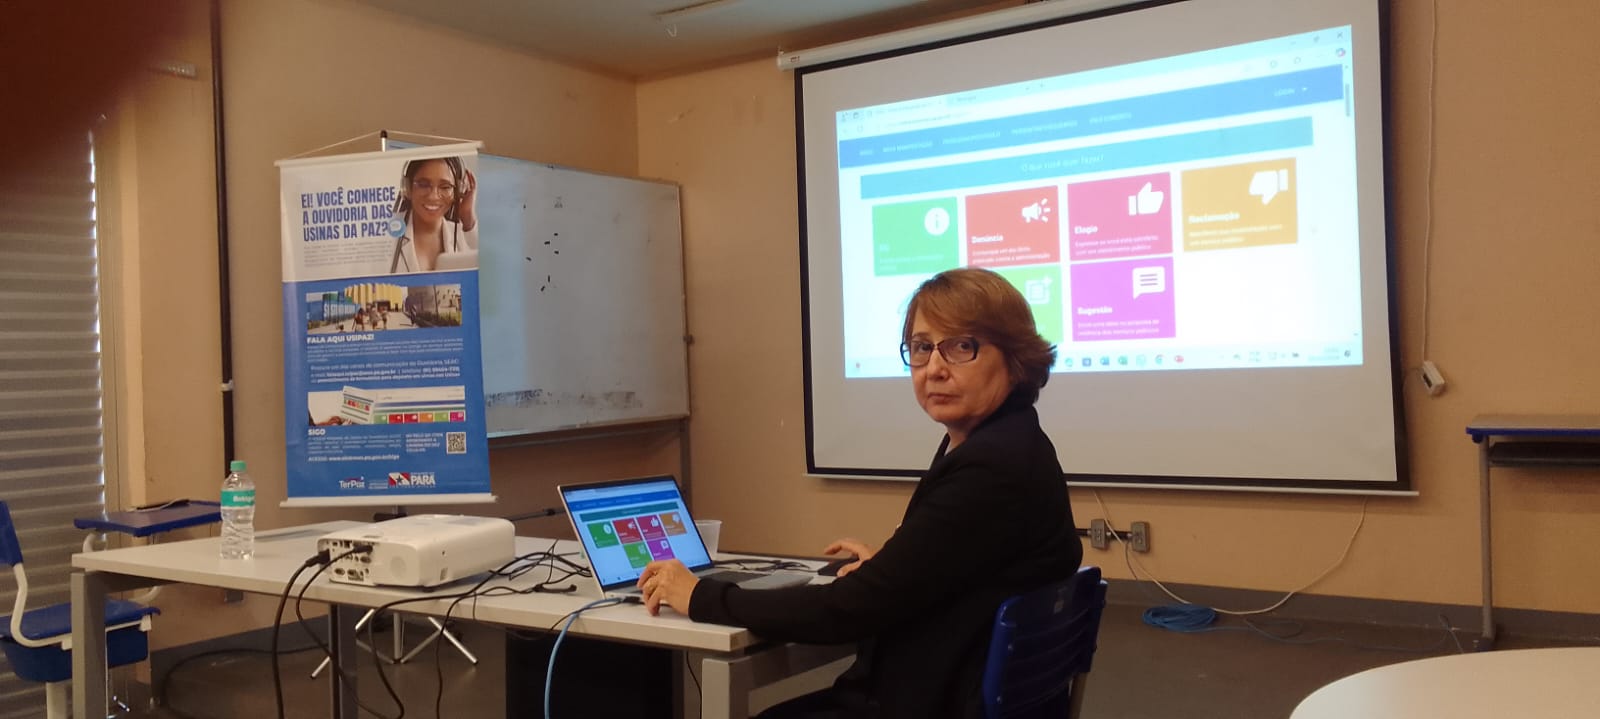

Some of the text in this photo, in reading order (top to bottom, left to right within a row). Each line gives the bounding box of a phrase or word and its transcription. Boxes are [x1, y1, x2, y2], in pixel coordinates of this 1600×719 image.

[301, 186, 396, 209] EI! VOCÊ CONHECE
[303, 204, 393, 226] A OUVIDORIA DAS
[303, 220, 388, 242] USINAS DA PAZ?
[1074, 226, 1098, 235] Elogio
[971, 233, 1004, 244] Denúncia
[1077, 306, 1113, 316] Sugestão
[307, 336, 326, 344] FALA
[327, 335, 344, 344] AQUI
[308, 428, 326, 436] SIGO
